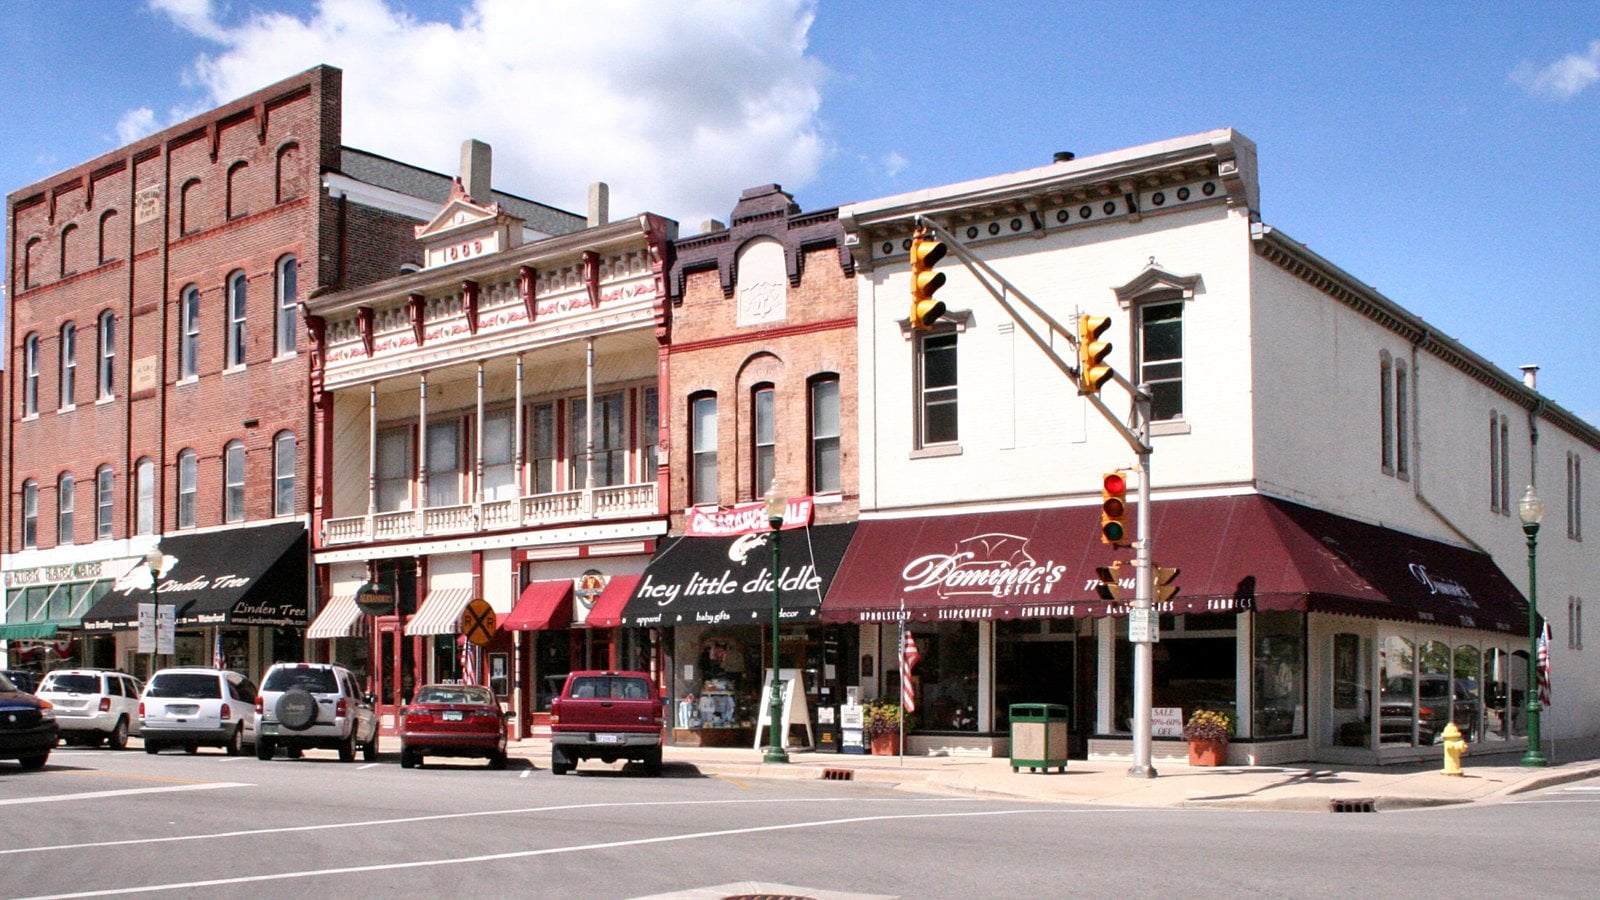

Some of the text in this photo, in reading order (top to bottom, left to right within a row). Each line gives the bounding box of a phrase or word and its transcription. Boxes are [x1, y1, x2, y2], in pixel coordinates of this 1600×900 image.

[692, 501, 809, 534] CLEARANCE ALE
[902, 551, 1067, 592] Dominic's
[149, 574, 250, 594] Linden Tree
[637, 565, 822, 606] hey little diddle
[992, 583, 1054, 596] DESIGN
[232, 601, 307, 616] Linden Tree
[636, 612, 663, 626] apparel
[695, 611, 715, 624] baby
[714, 609, 731, 624] gifts
[860, 611, 912, 621] UPHOLSTERY
[938, 608, 993, 619] SLIPCOVERS
[1021, 605, 1076, 617] FURNITURE
[1207, 599, 1252, 611] FABRICS
[1154, 709, 1174, 717] SALE
[1157, 727, 1173, 736] OFF
